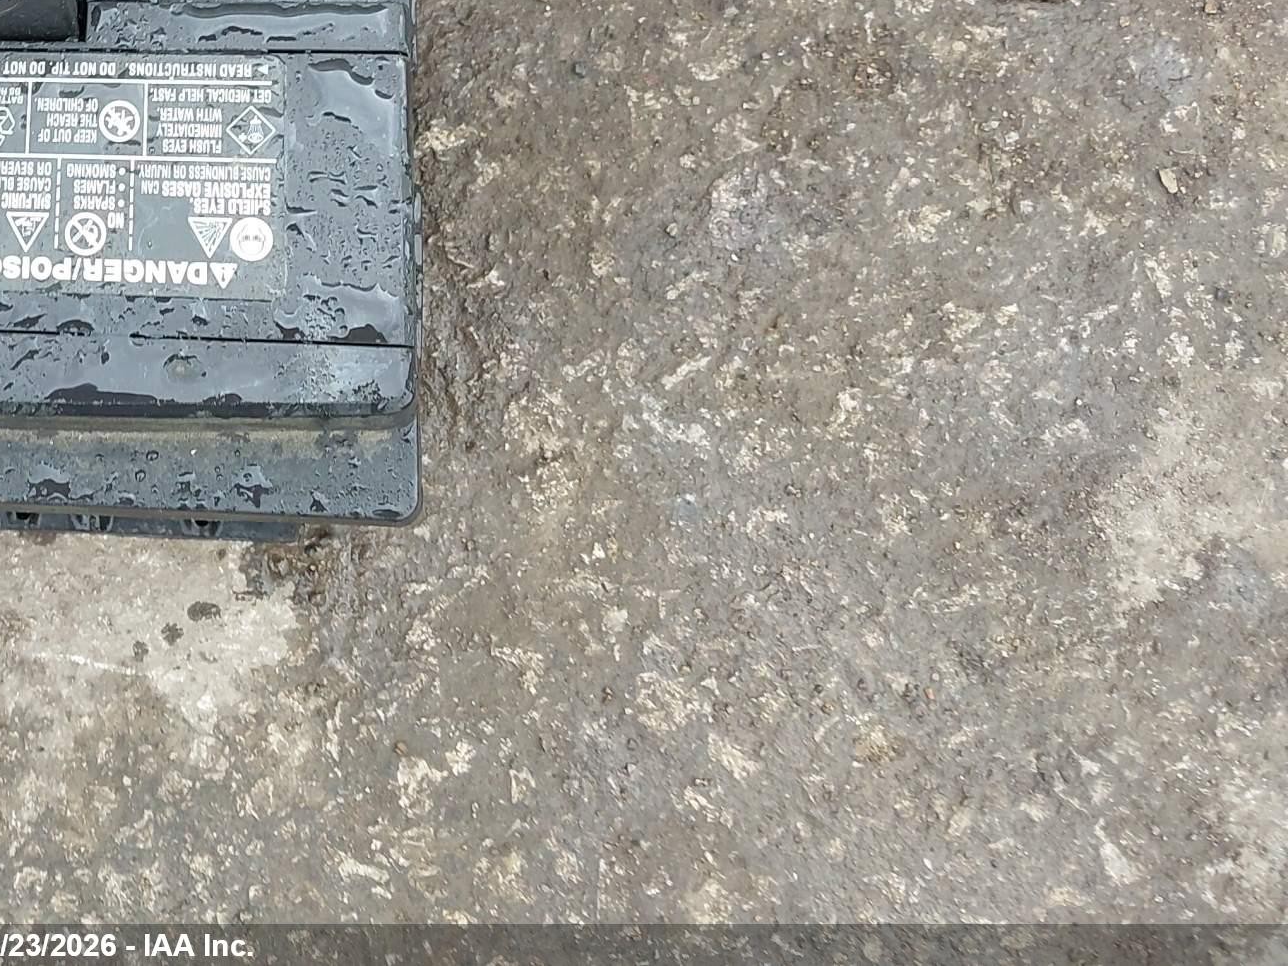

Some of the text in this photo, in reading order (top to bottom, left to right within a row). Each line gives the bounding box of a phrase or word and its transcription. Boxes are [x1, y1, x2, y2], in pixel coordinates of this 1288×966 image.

[3, 61, 26, 75] NOT
[29, 61, 45, 75] DO
[49, 61, 70, 75] TIP.
[73, 62, 96, 75] NOT
[100, 62, 115, 76] DO
[125, 62, 216, 77] INSTRUCTIONS.
[220, 64, 252, 78] READ
[150, 88, 272, 103] GET MEDICAL HELP FAST.
[34, 98, 98, 112] OF CHILDREN.
[46, 113, 97, 127] THE REACH
[157, 107, 222, 122] WITH WATER.
[38, 129, 97, 143] KEEP OUT OF
[157, 123, 222, 138] IMMEDIATELY
[163, 138, 222, 153] FLUSH EYES
[37, 161, 52, 175] OR
[67, 163, 116, 178] SMOKING
[138, 164, 271, 181] CAUSE BLINDNESS OR INJURY.
[17, 177, 52, 191] CAUSE
[74, 179, 115, 194] FLAMES
[141, 180, 271, 199] EXPLOSIVE GASES CAN
[1, 192, 51, 209] SULFURIC
[74, 195, 115, 209] SPARKS
[228, 199, 271, 215] SHIELD
[107, 212, 124, 229] NO
